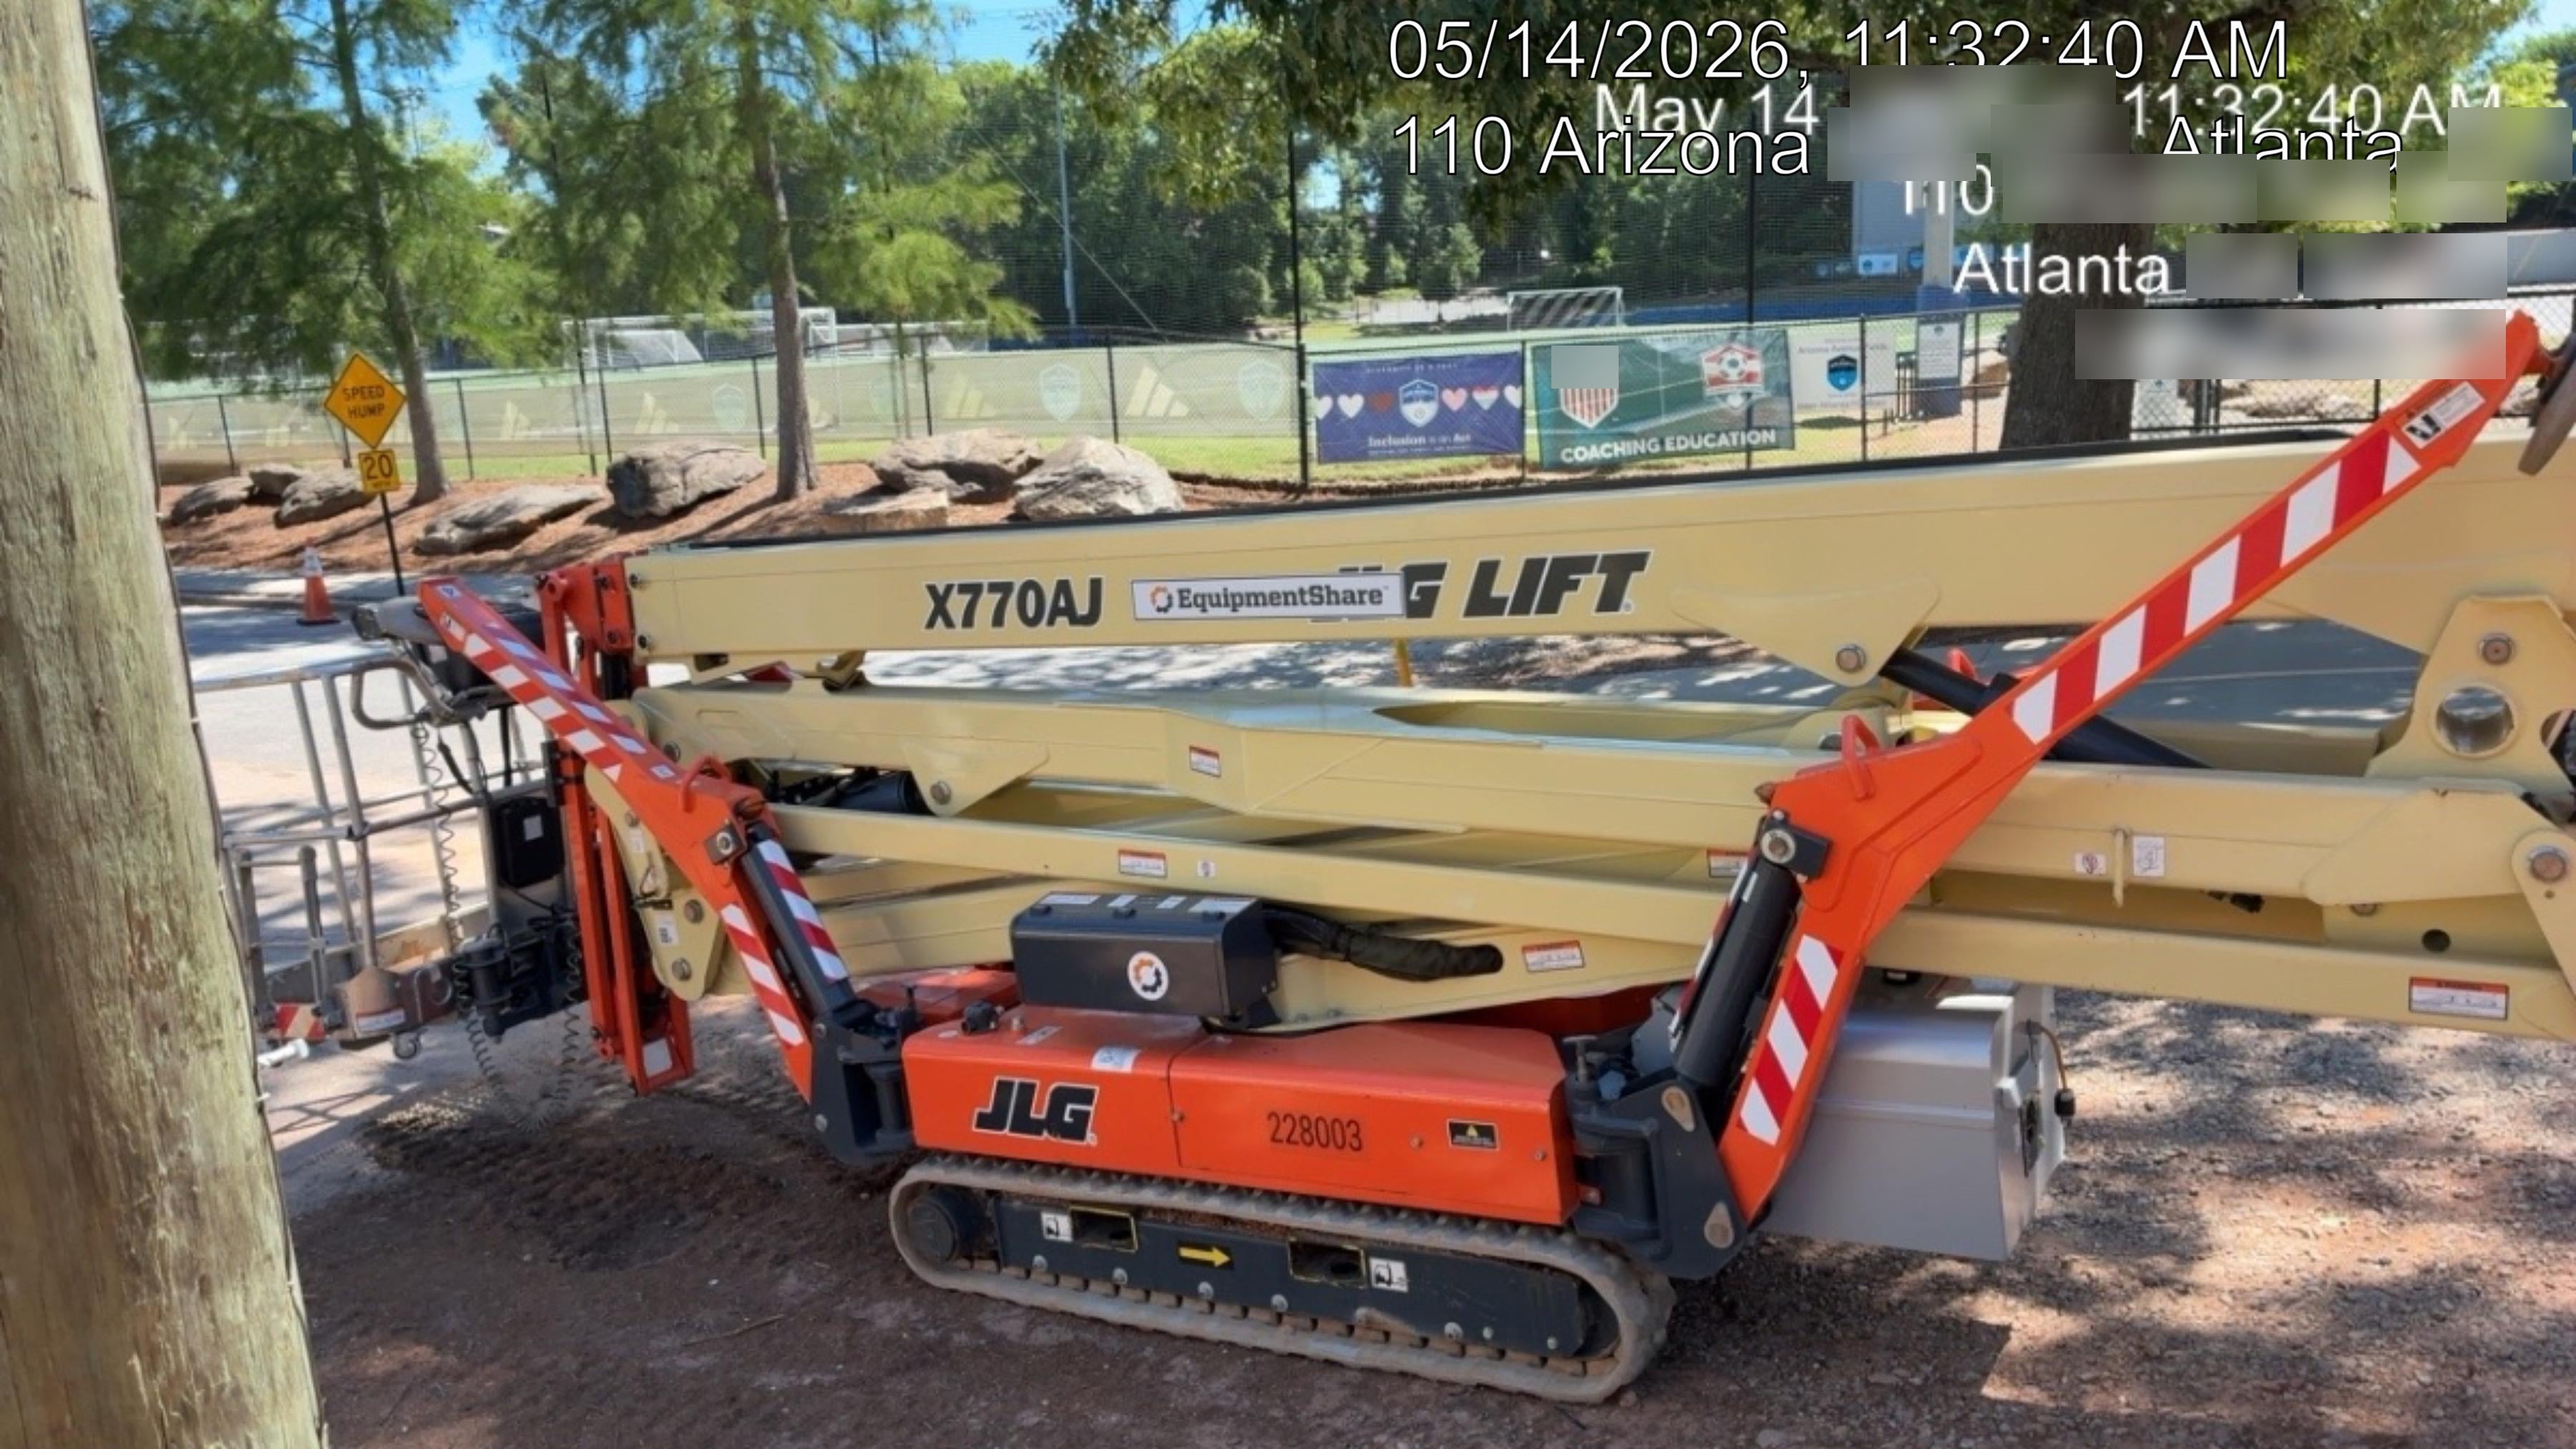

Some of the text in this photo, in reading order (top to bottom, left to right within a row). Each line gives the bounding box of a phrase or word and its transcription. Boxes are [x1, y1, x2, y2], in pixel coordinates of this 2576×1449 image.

[343, 384, 385, 401] SPEED
[347, 403, 386, 419] HUMP
[1367, 434, 1426, 447] Inclusion
[1560, 428, 1777, 464] COACHING EDUCATION
[364, 454, 394, 481] 20
[1177, 585, 1384, 613] EquipmentShare
[1462, 550, 1652, 618] LIFT
[924, 577, 1103, 630] X770AJ
[973, 1075, 1100, 1145] JLG
[1267, 1111, 1363, 1151] 228003
